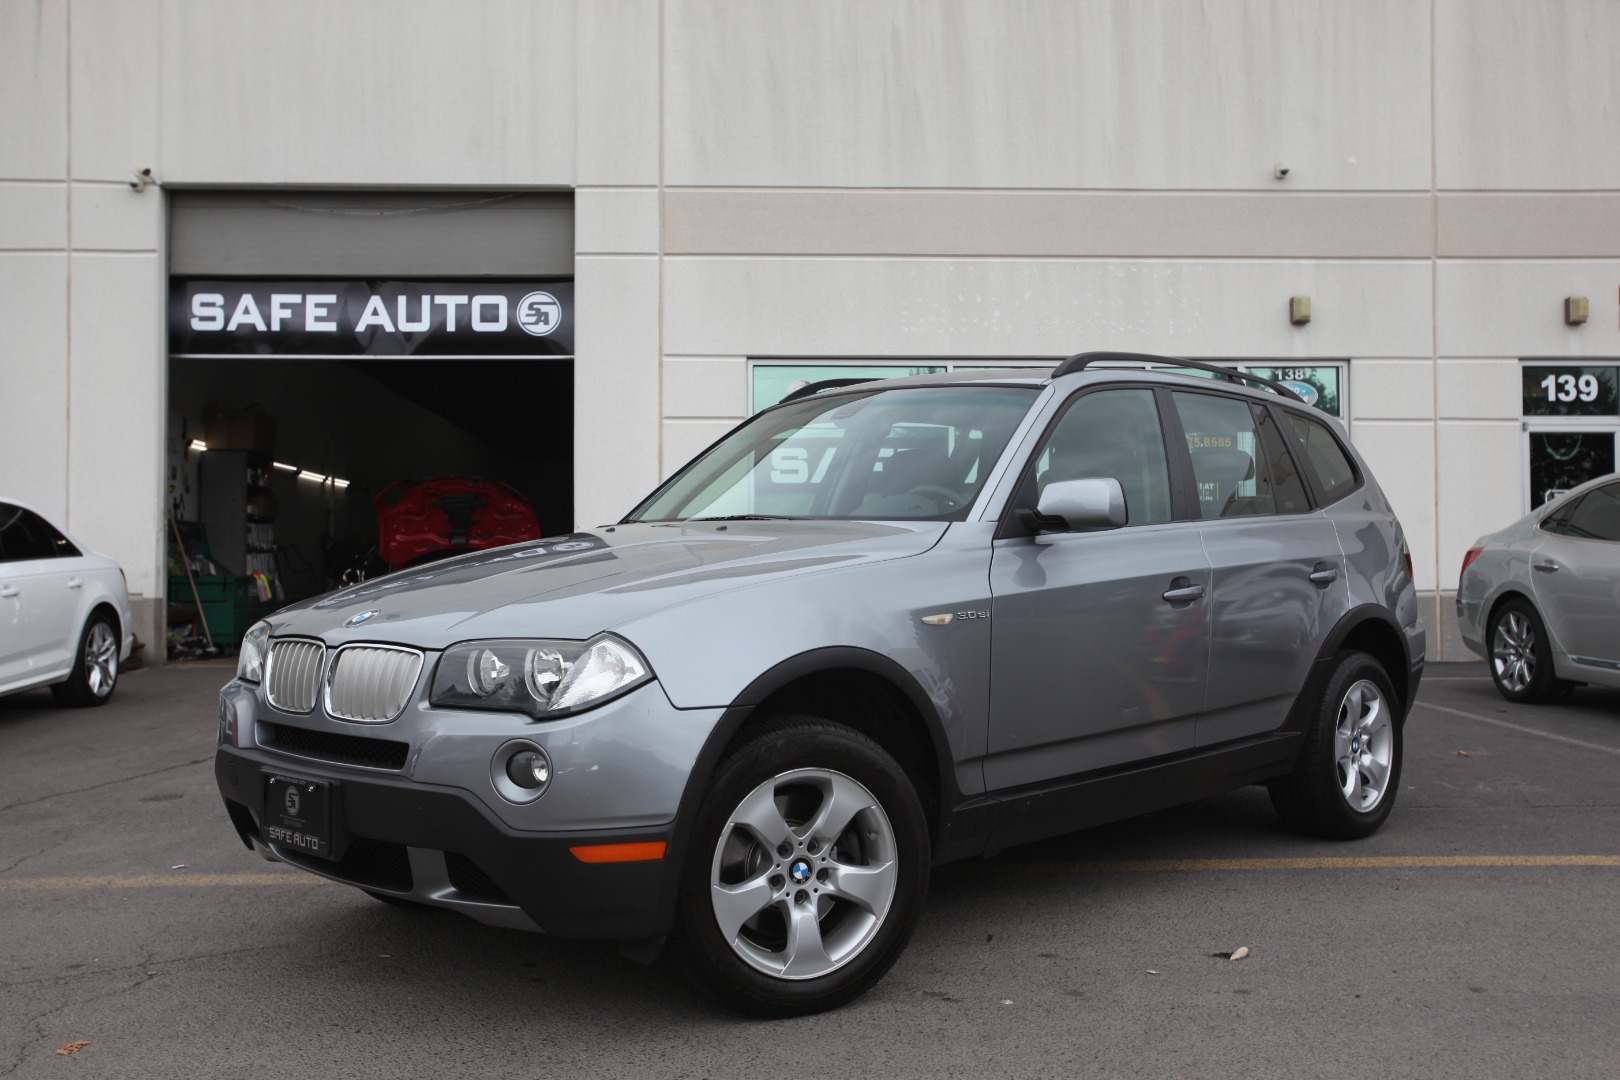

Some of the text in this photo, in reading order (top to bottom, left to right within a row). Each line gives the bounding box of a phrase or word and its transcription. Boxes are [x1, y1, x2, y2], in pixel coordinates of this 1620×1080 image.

[190, 292, 337, 332] SAFE
[355, 293, 508, 333] AUTO
[1275, 367, 1304, 380] 138
[1541, 374, 1598, 402] 139
[269, 827, 319, 850] SAFE AUTO
